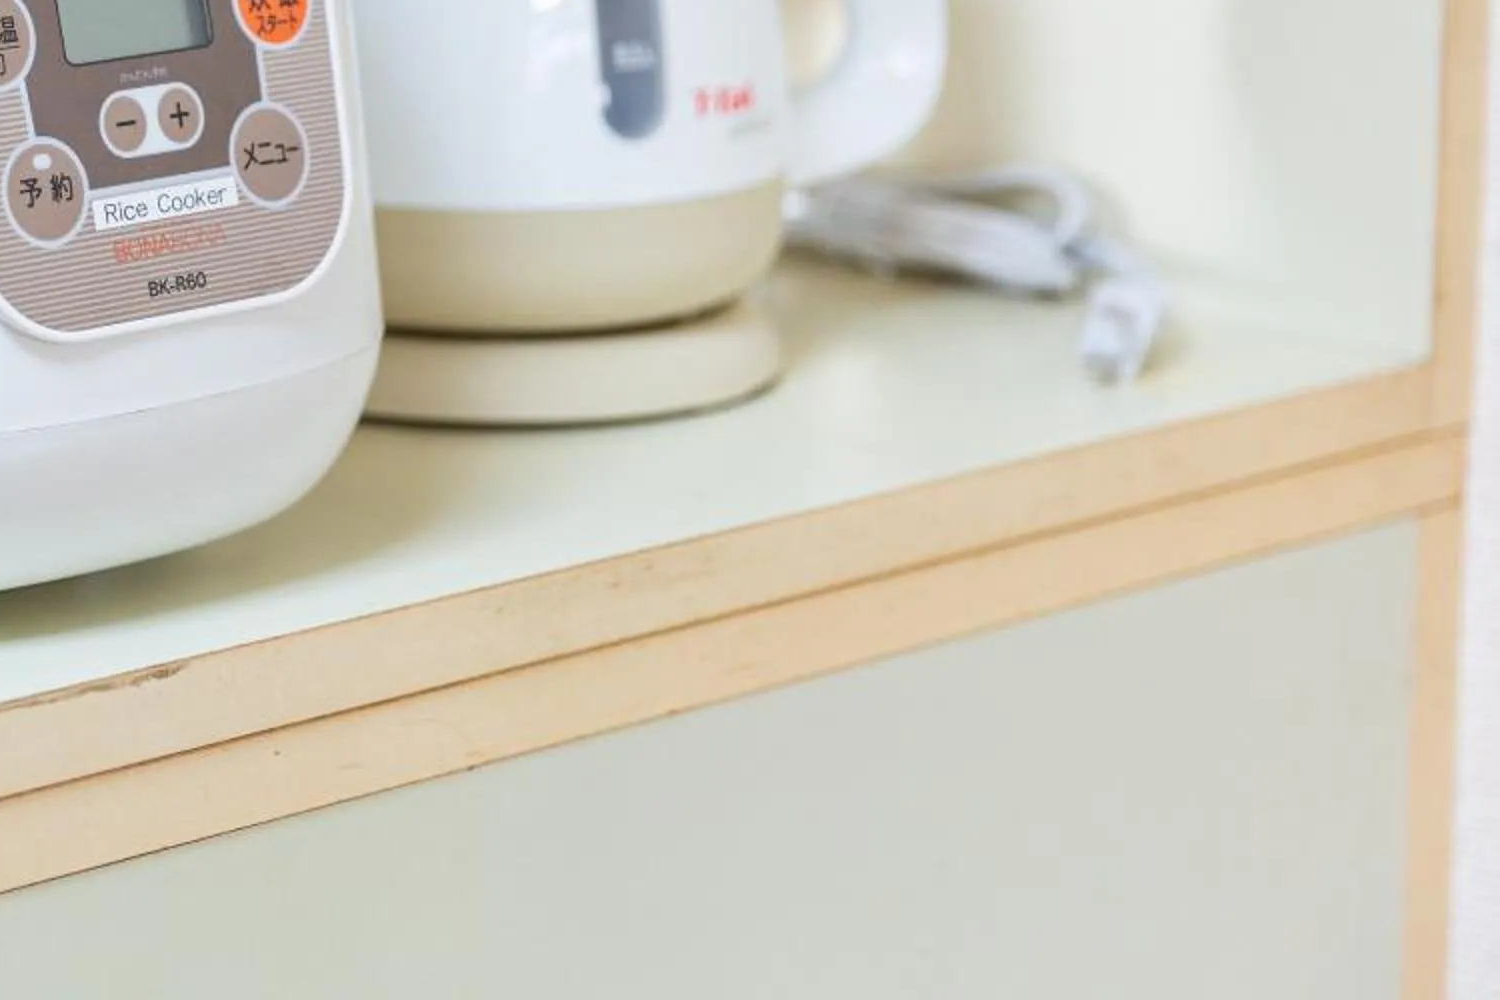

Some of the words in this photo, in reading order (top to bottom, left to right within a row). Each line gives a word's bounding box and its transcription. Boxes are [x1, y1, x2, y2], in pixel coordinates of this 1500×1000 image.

[256, 10, 298, 36] スタート
[242, 141, 299, 170] メニュー
[19, 171, 73, 208] 予約
[104, 202, 149, 224] Rice
[157, 187, 227, 214] Cooker
[147, 271, 208, 298] BK-R60
